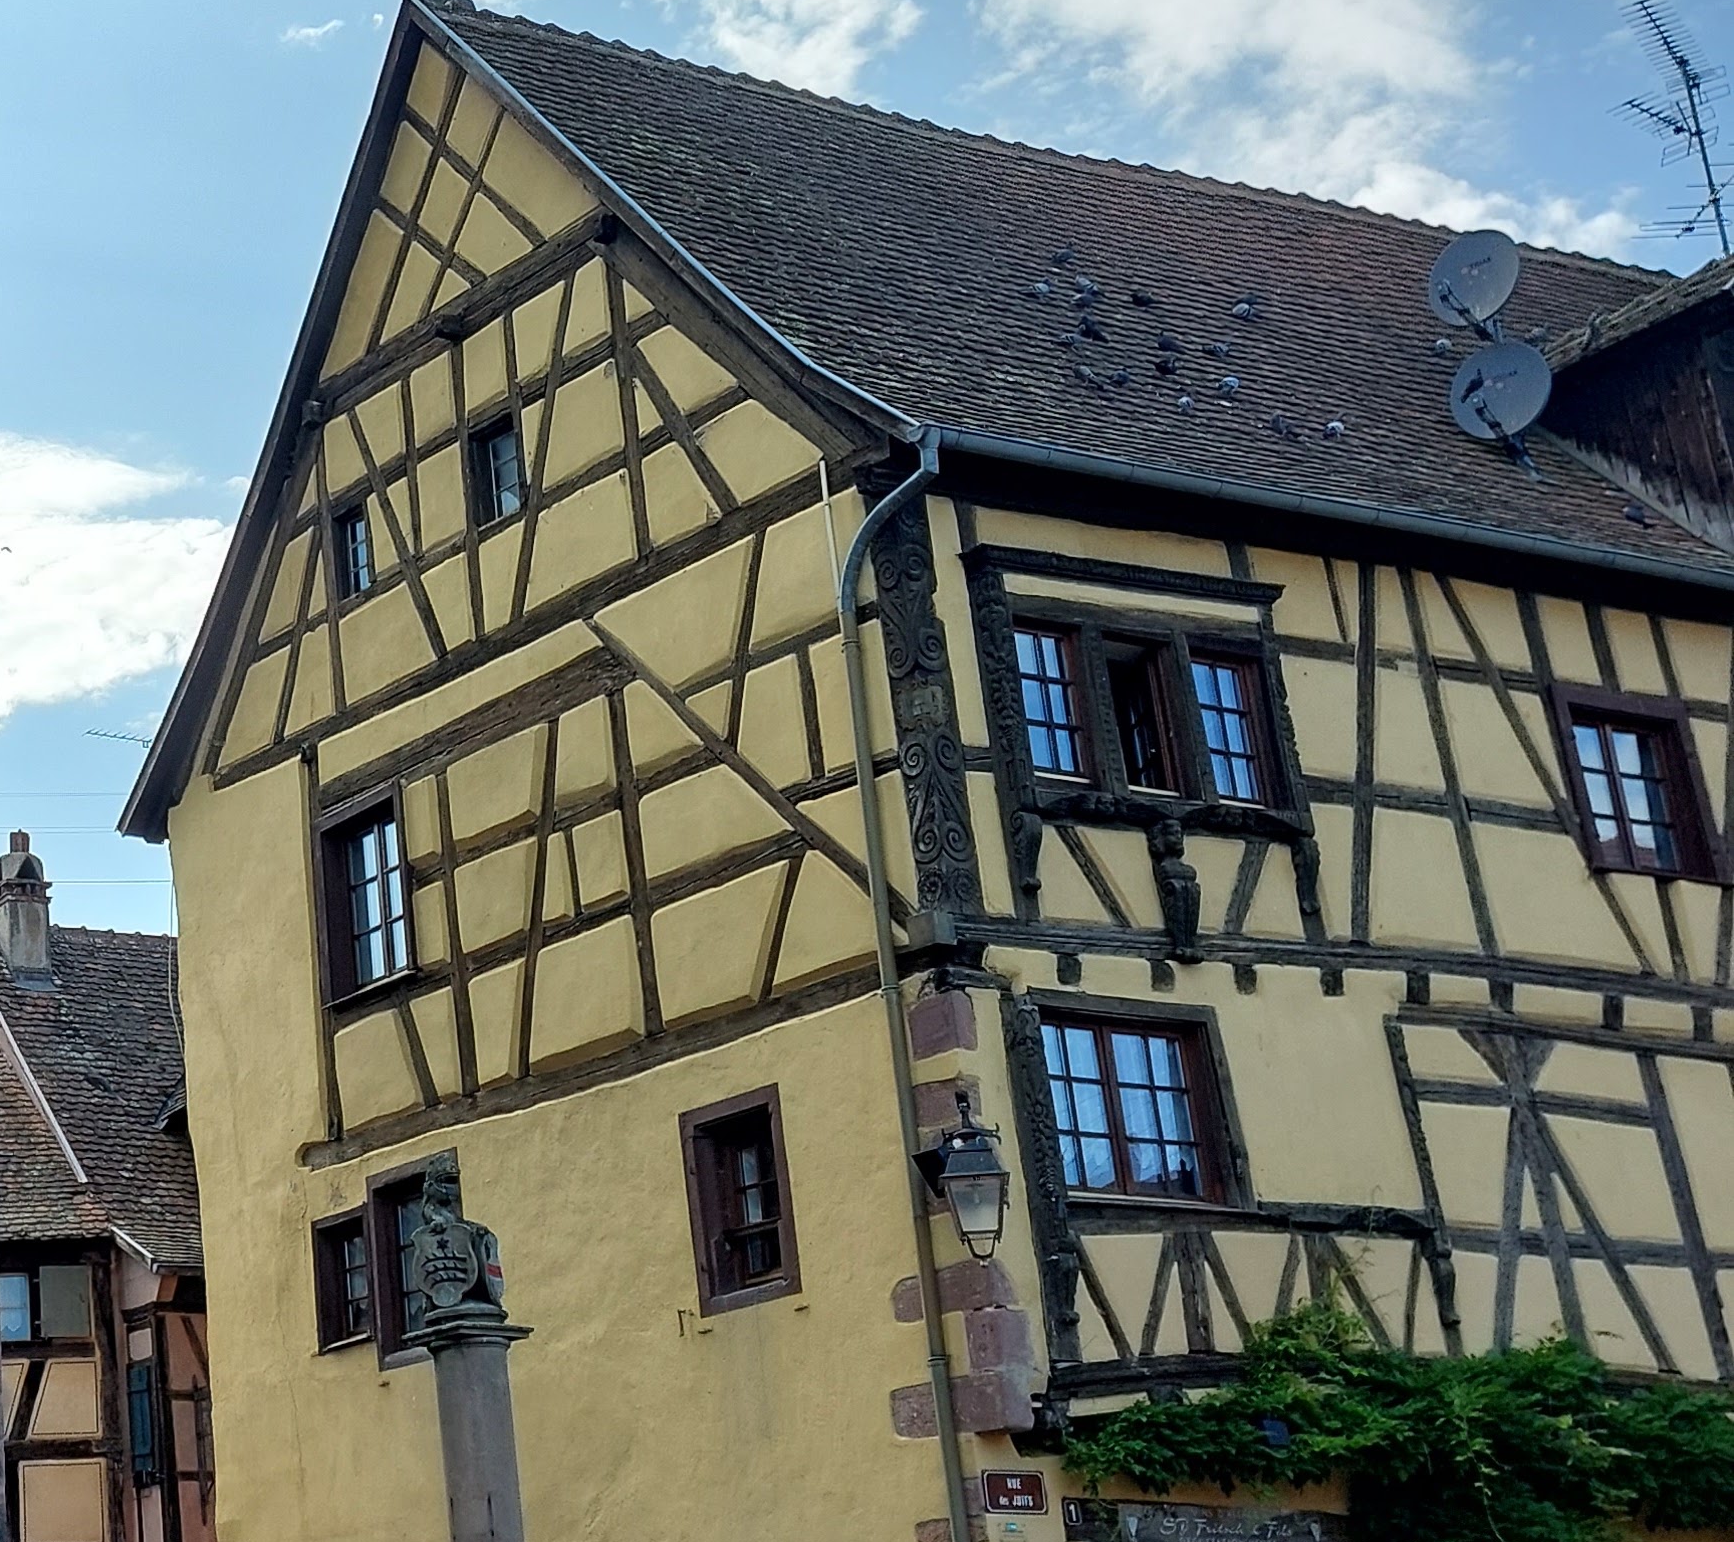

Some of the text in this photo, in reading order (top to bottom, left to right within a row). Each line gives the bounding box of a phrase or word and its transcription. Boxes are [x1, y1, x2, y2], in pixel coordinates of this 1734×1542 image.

[1006, 1477, 1022, 1490] RUE
[999, 1495, 1034, 1507] des JUIFS
[1068, 1503, 1077, 1522] 1
